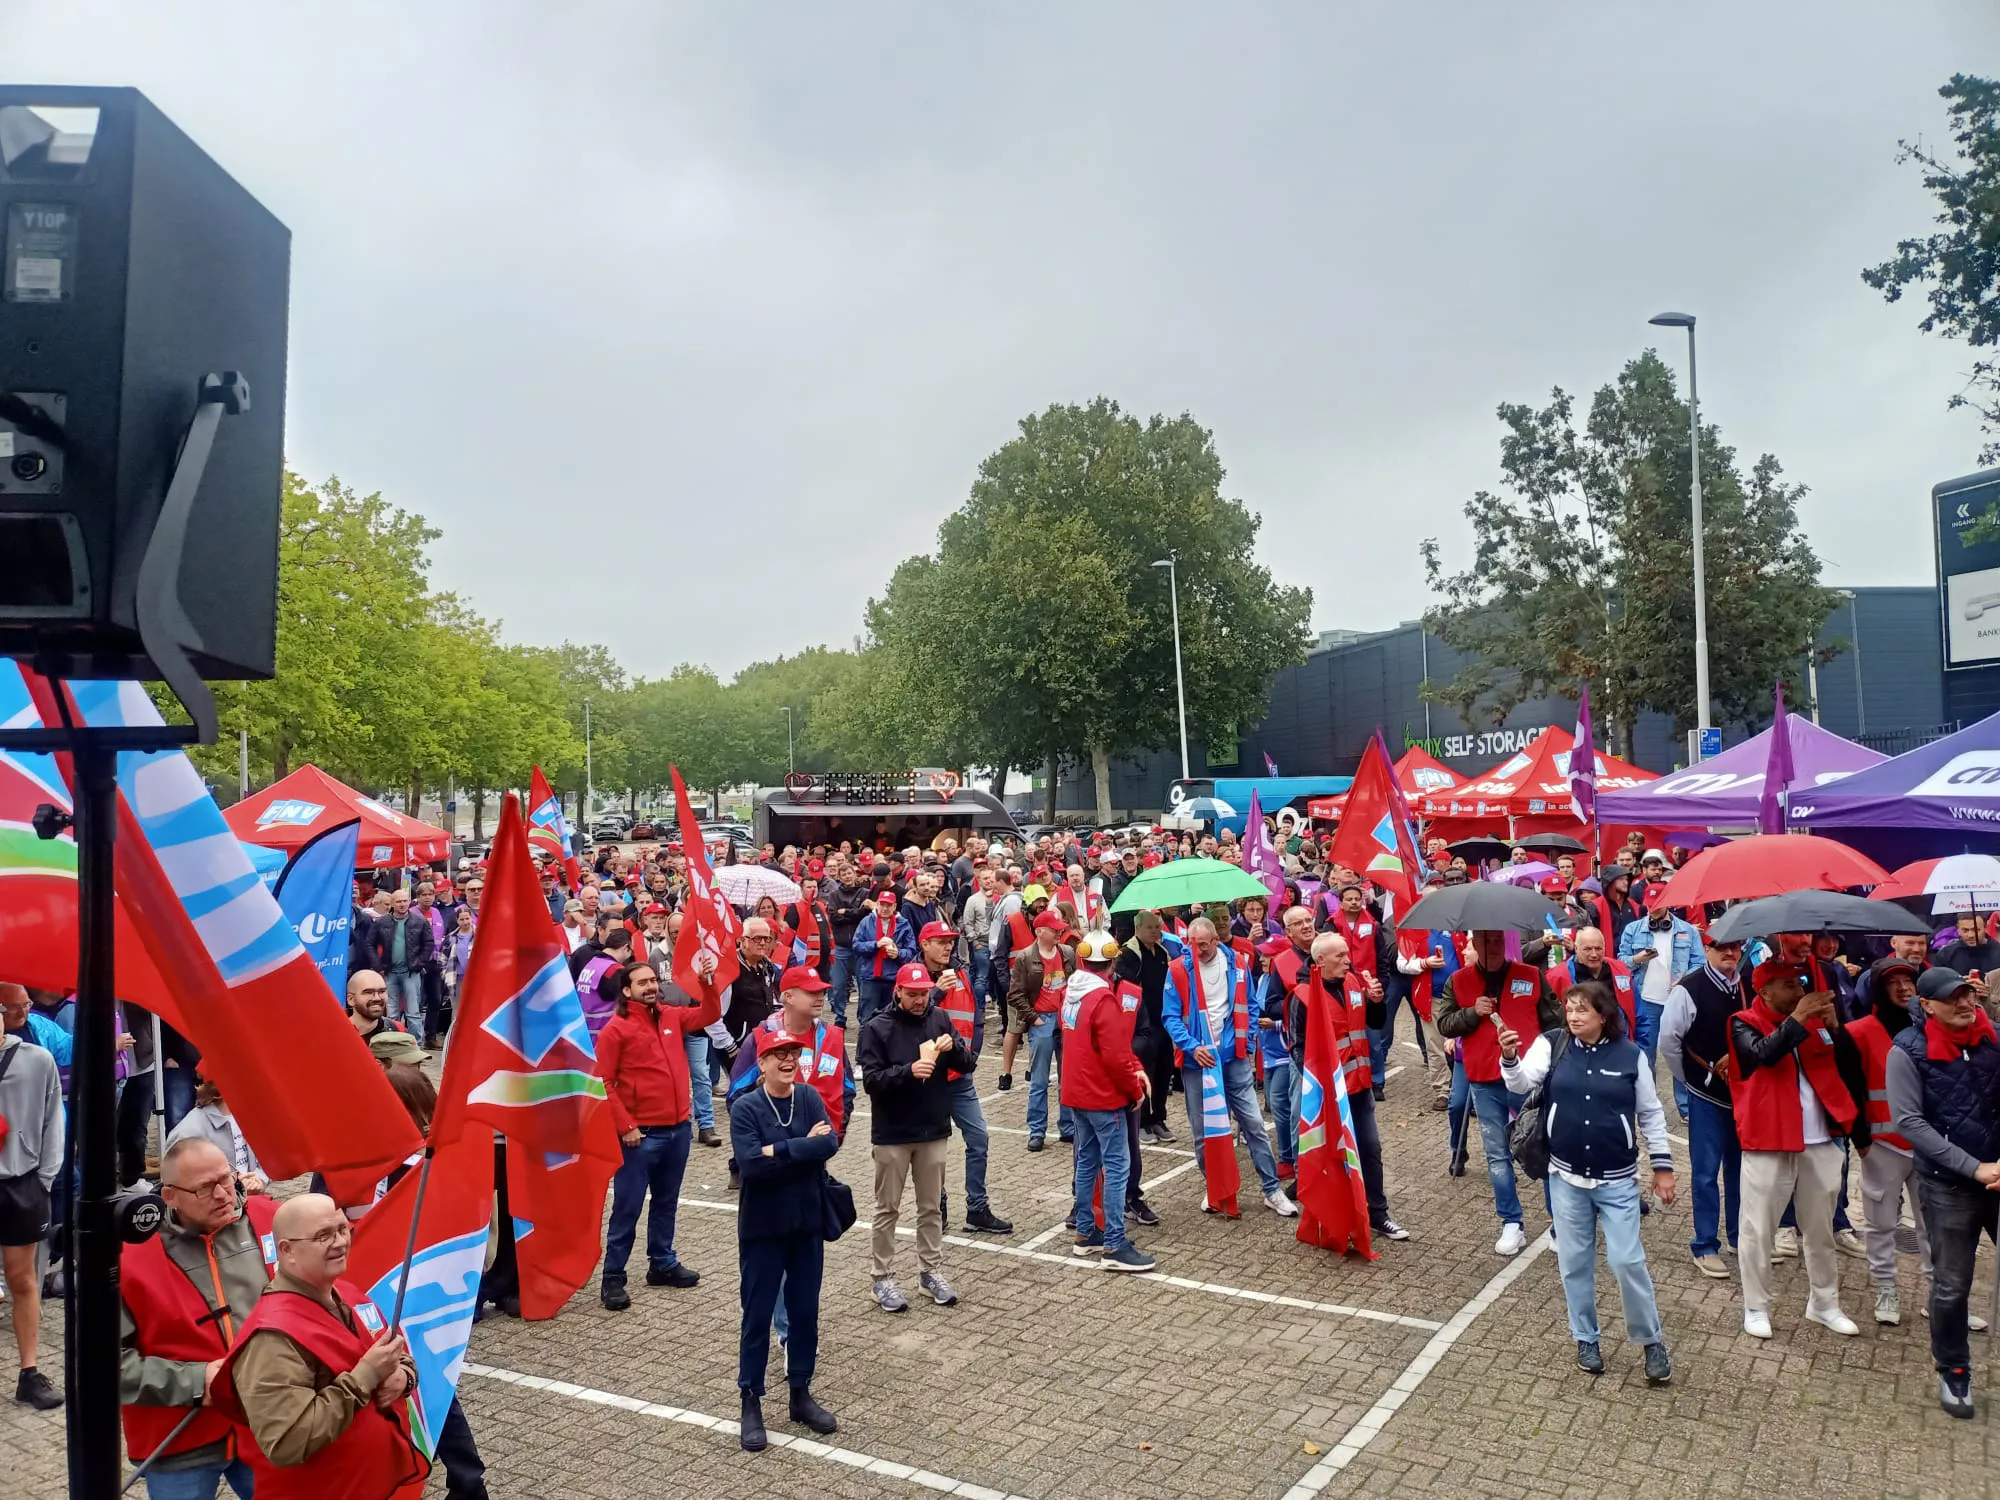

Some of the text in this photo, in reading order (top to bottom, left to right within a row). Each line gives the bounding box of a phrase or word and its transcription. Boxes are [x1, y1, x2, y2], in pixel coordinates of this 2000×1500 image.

[1951, 517, 1976, 528] INGANG
[1444, 735, 1475, 758] SELF
[1477, 726, 1548, 756] STORAG
[823, 772, 923, 806] FRIET
[263, 804, 319, 820] FNV
